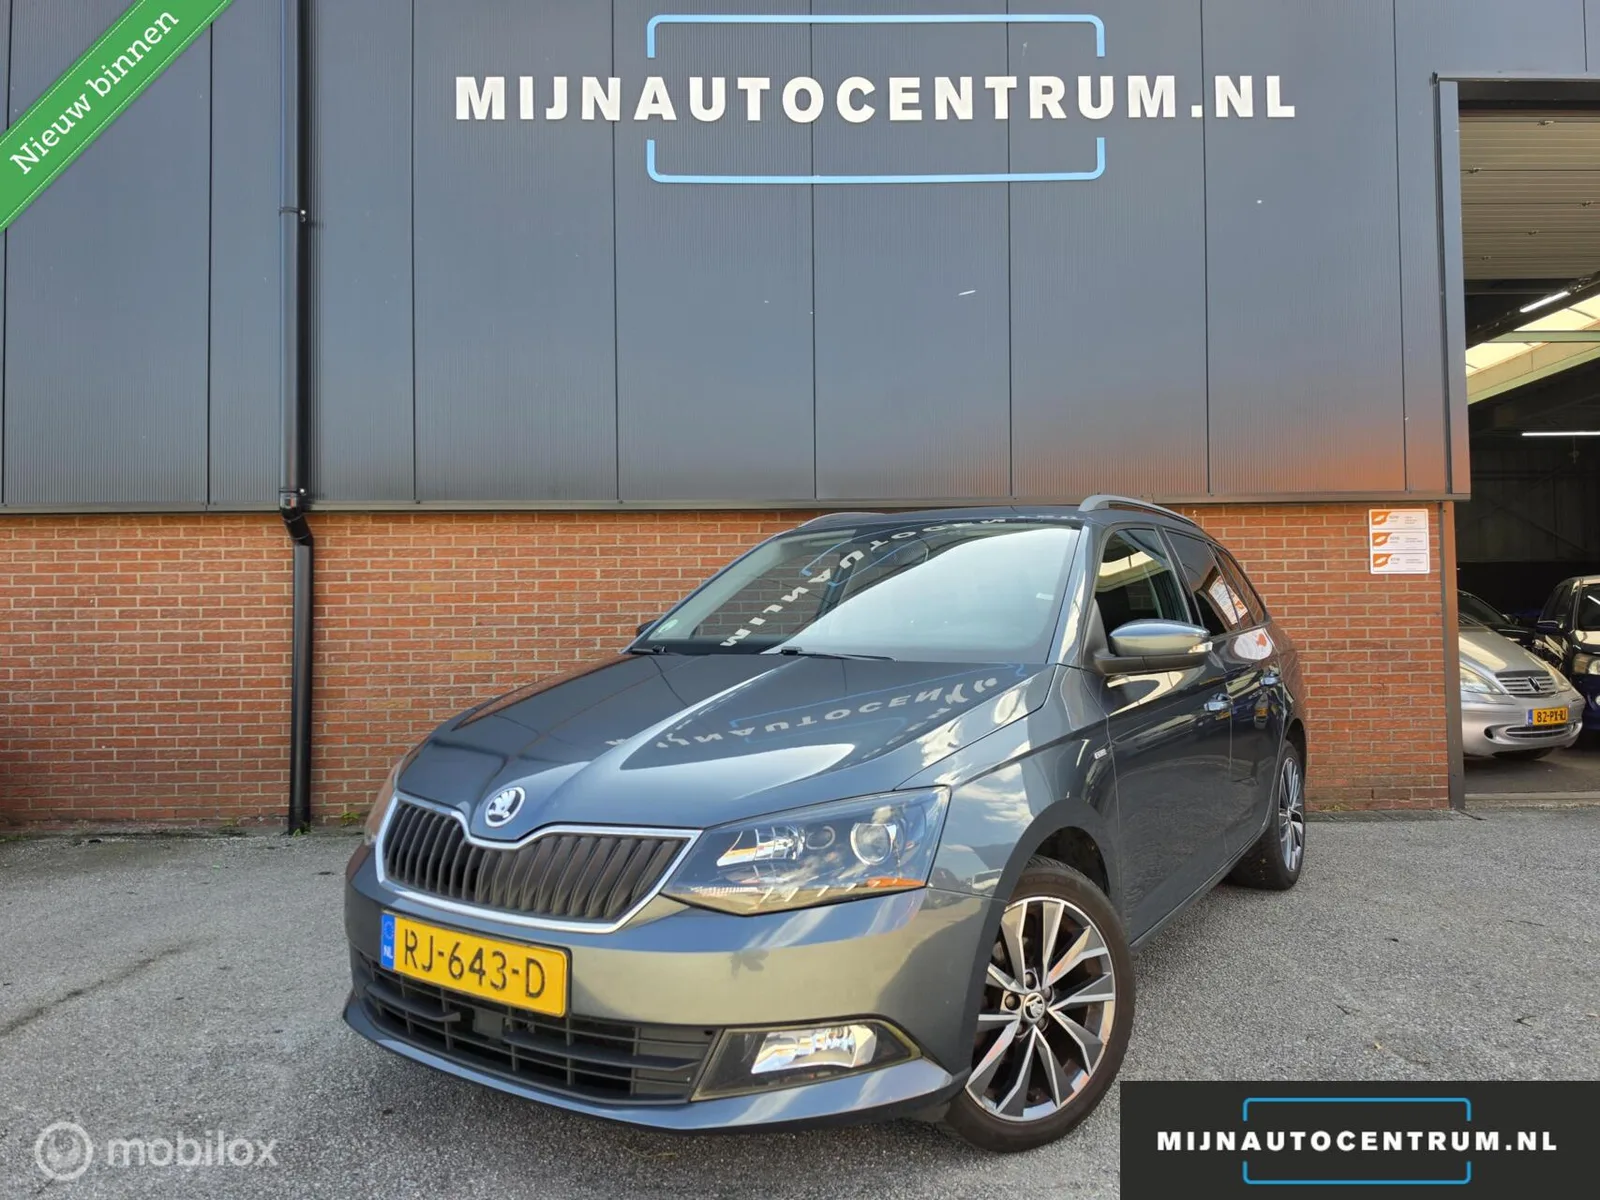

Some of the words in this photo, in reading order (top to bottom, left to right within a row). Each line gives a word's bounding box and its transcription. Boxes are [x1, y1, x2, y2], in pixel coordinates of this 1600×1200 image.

[455, 75, 1296, 123] MIJNAUTOCENTRUM.NL
[383, 945, 394, 960] NL
[404, 928, 546, 999] RJ-643-D
